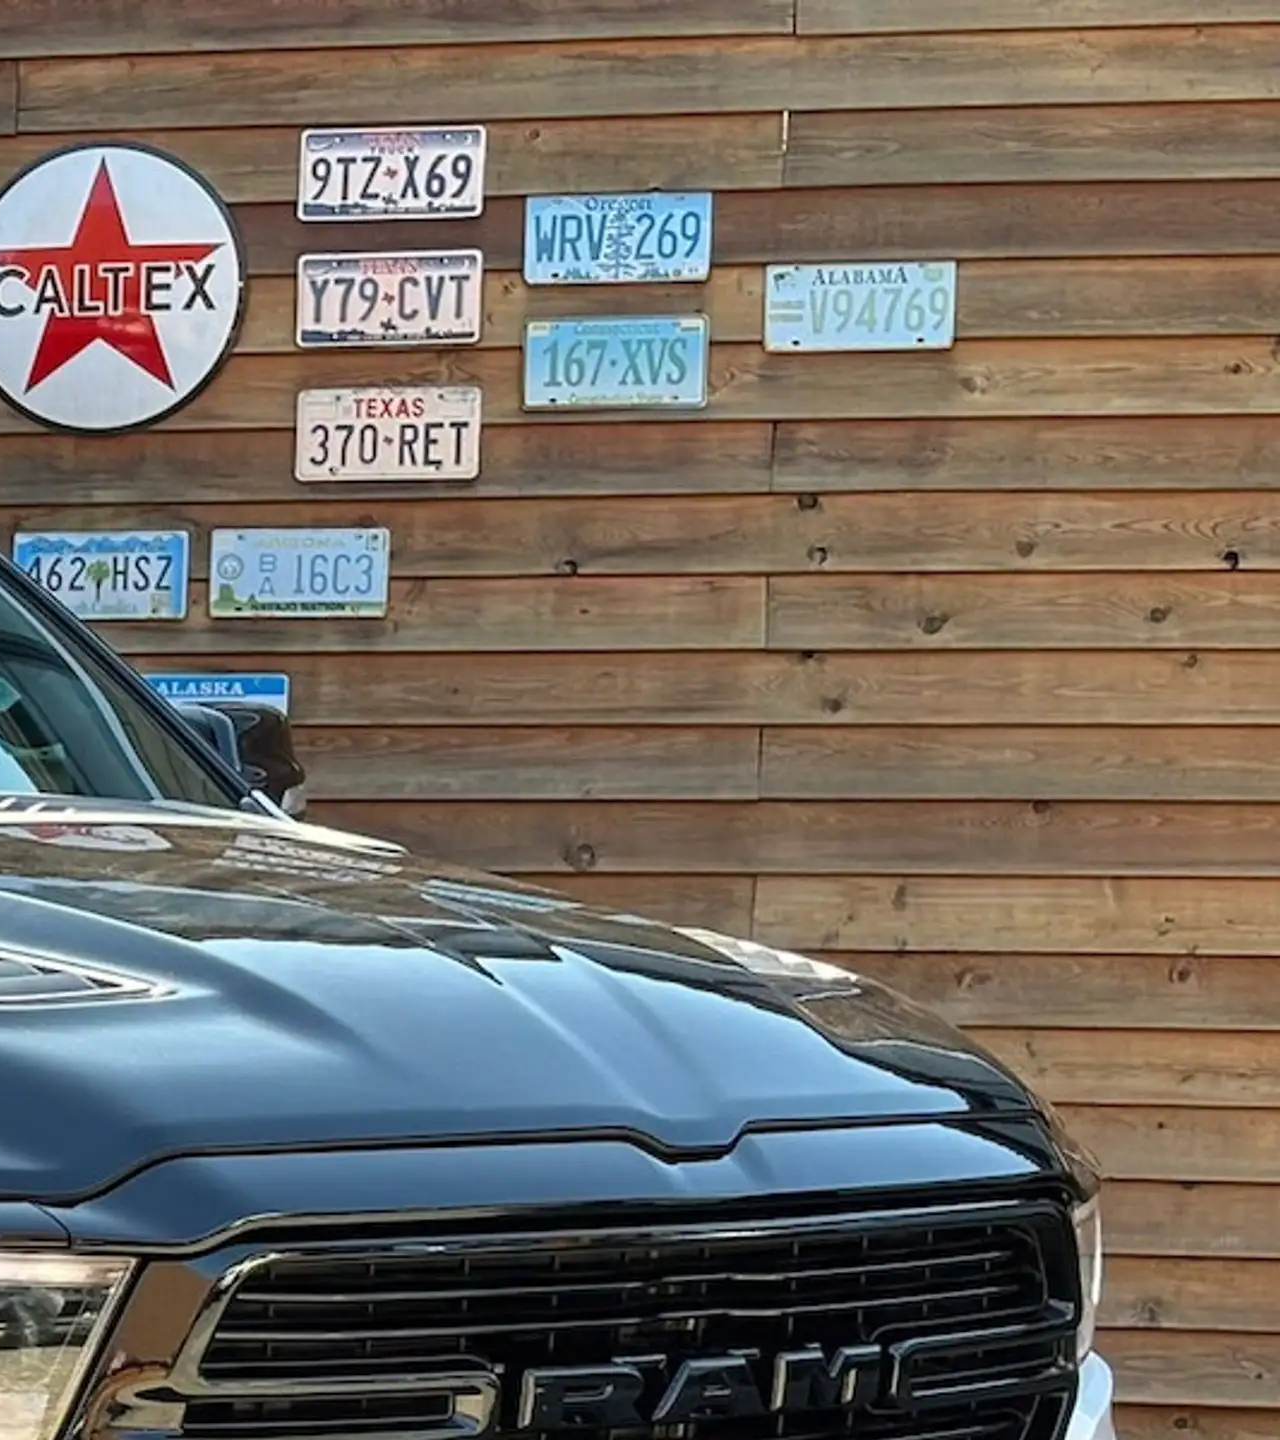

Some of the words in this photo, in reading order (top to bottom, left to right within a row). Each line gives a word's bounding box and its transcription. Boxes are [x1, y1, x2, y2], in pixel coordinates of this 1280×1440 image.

[812, 266, 909, 286] ALABAMA
[809, 286, 949, 334] V94769
[354, 396, 425, 419] TEXAS
[156, 681, 244, 695] ALASKA
[518, 1343, 882, 1429] RAM
